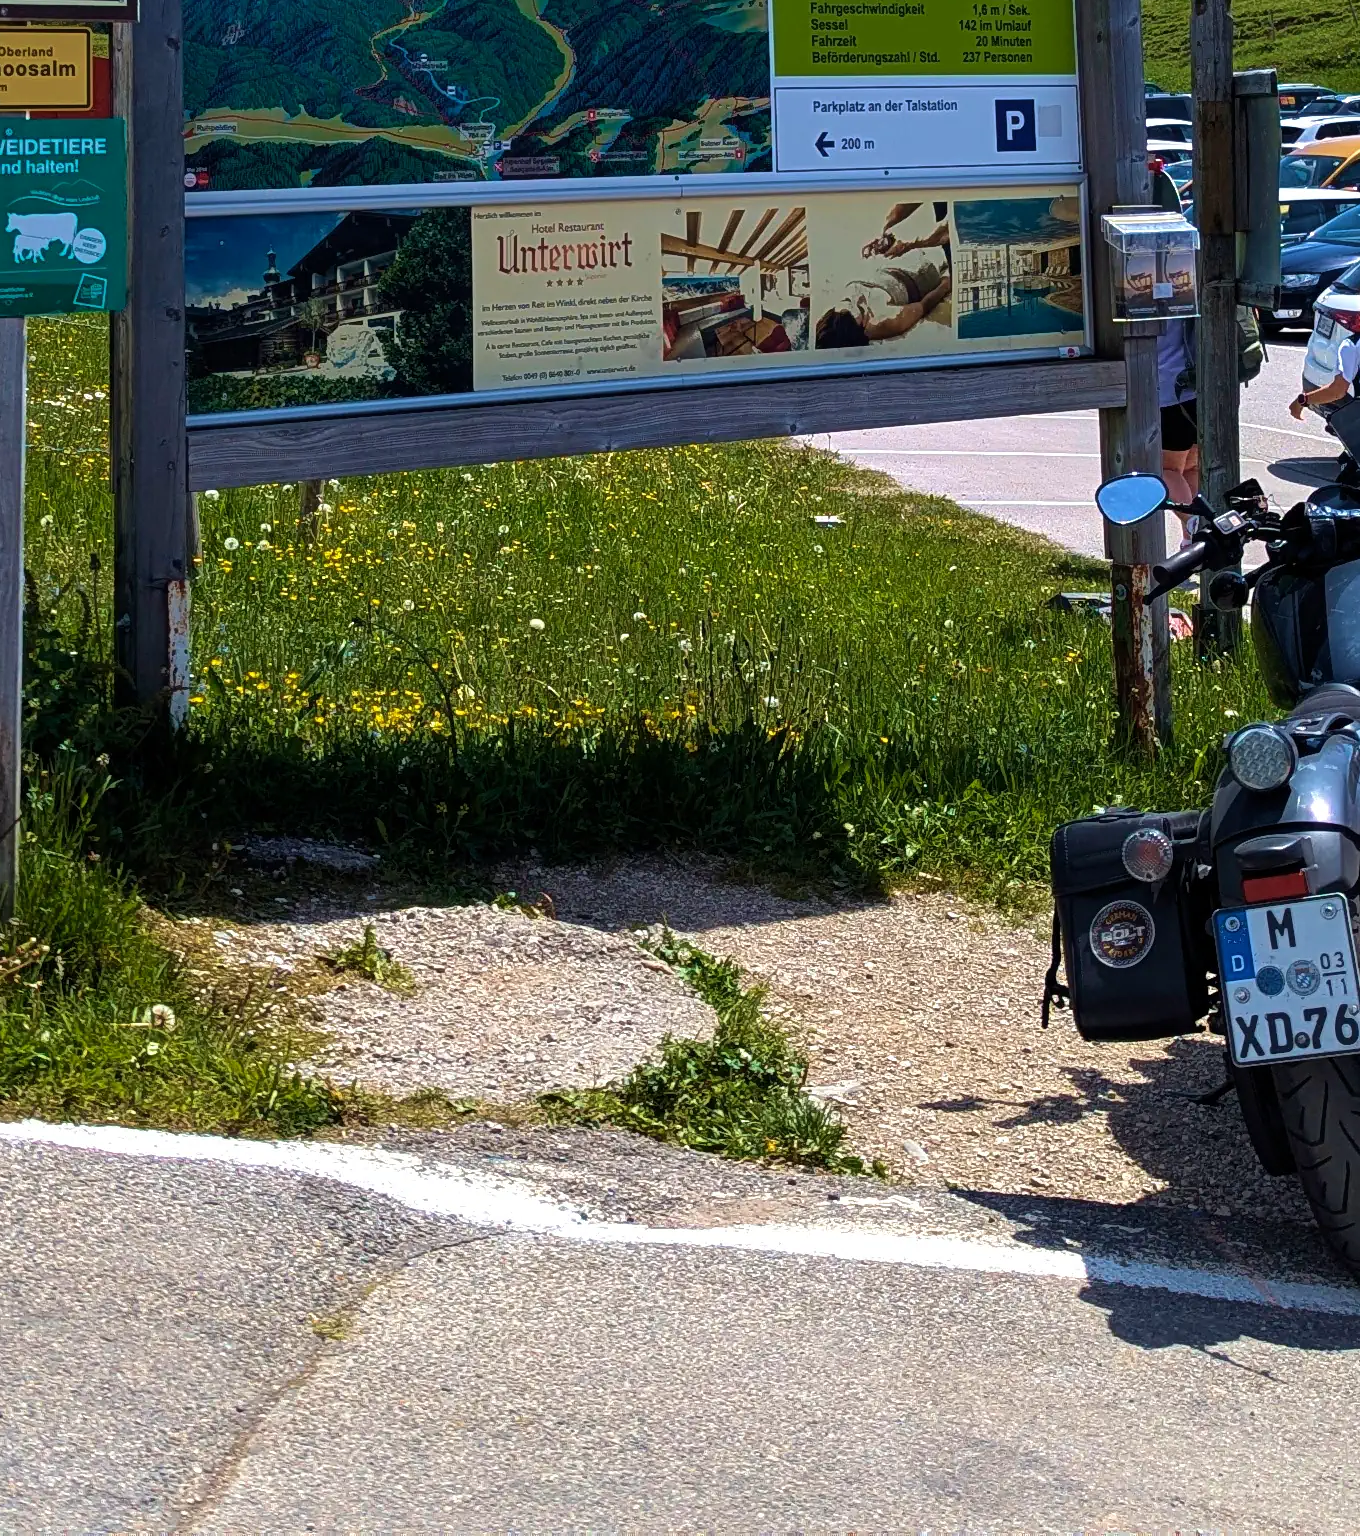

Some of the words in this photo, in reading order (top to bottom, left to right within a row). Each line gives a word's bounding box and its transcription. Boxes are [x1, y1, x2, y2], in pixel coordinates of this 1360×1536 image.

[810, 3, 925, 17] Fahrgeschwindigkeit
[972, 4, 988, 17] 1,6
[990, 7, 1000, 16] m
[1008, 5, 1030, 16] Sek.
[811, 19, 849, 31] Sessel
[959, 20, 977, 32] 142
[979, 20, 992, 32] im
[995, 20, 1031, 32] Umlauf
[811, 35, 857, 47] Fahrzeit
[975, 36, 989, 47] 20
[991, 36, 1032, 47] Minuten
[812, 51, 911, 66] Beförderungszahl
[919, 52, 940, 64] Std.
[962, 52, 981, 64] 237
[983, 52, 1033, 64] Personen
[813, 100, 866, 115] Parkplatz
[868, 102, 882, 112] an
[885, 101, 904, 112] der
[905, 99, 958, 111] Talstation
[1006, 110, 1025, 141] P
[841, 138, 861, 150] 200
[864, 140, 875, 149] m
[26, 159, 79, 174] halten!
[532, 223, 555, 234] Hotel
[558, 222, 604, 232] Restaurant
[497, 230, 632, 275] Unterwirt
[631, 294, 652, 302] Kirche
[1266, 908, 1297, 950] M
[1231, 954, 1245, 972] D
[1320, 951, 1345, 969] 03
[1326, 978, 1348, 997] 11
[1236, 1011, 1294, 1059] XD
[1304, 1003, 1360, 1049] 76
